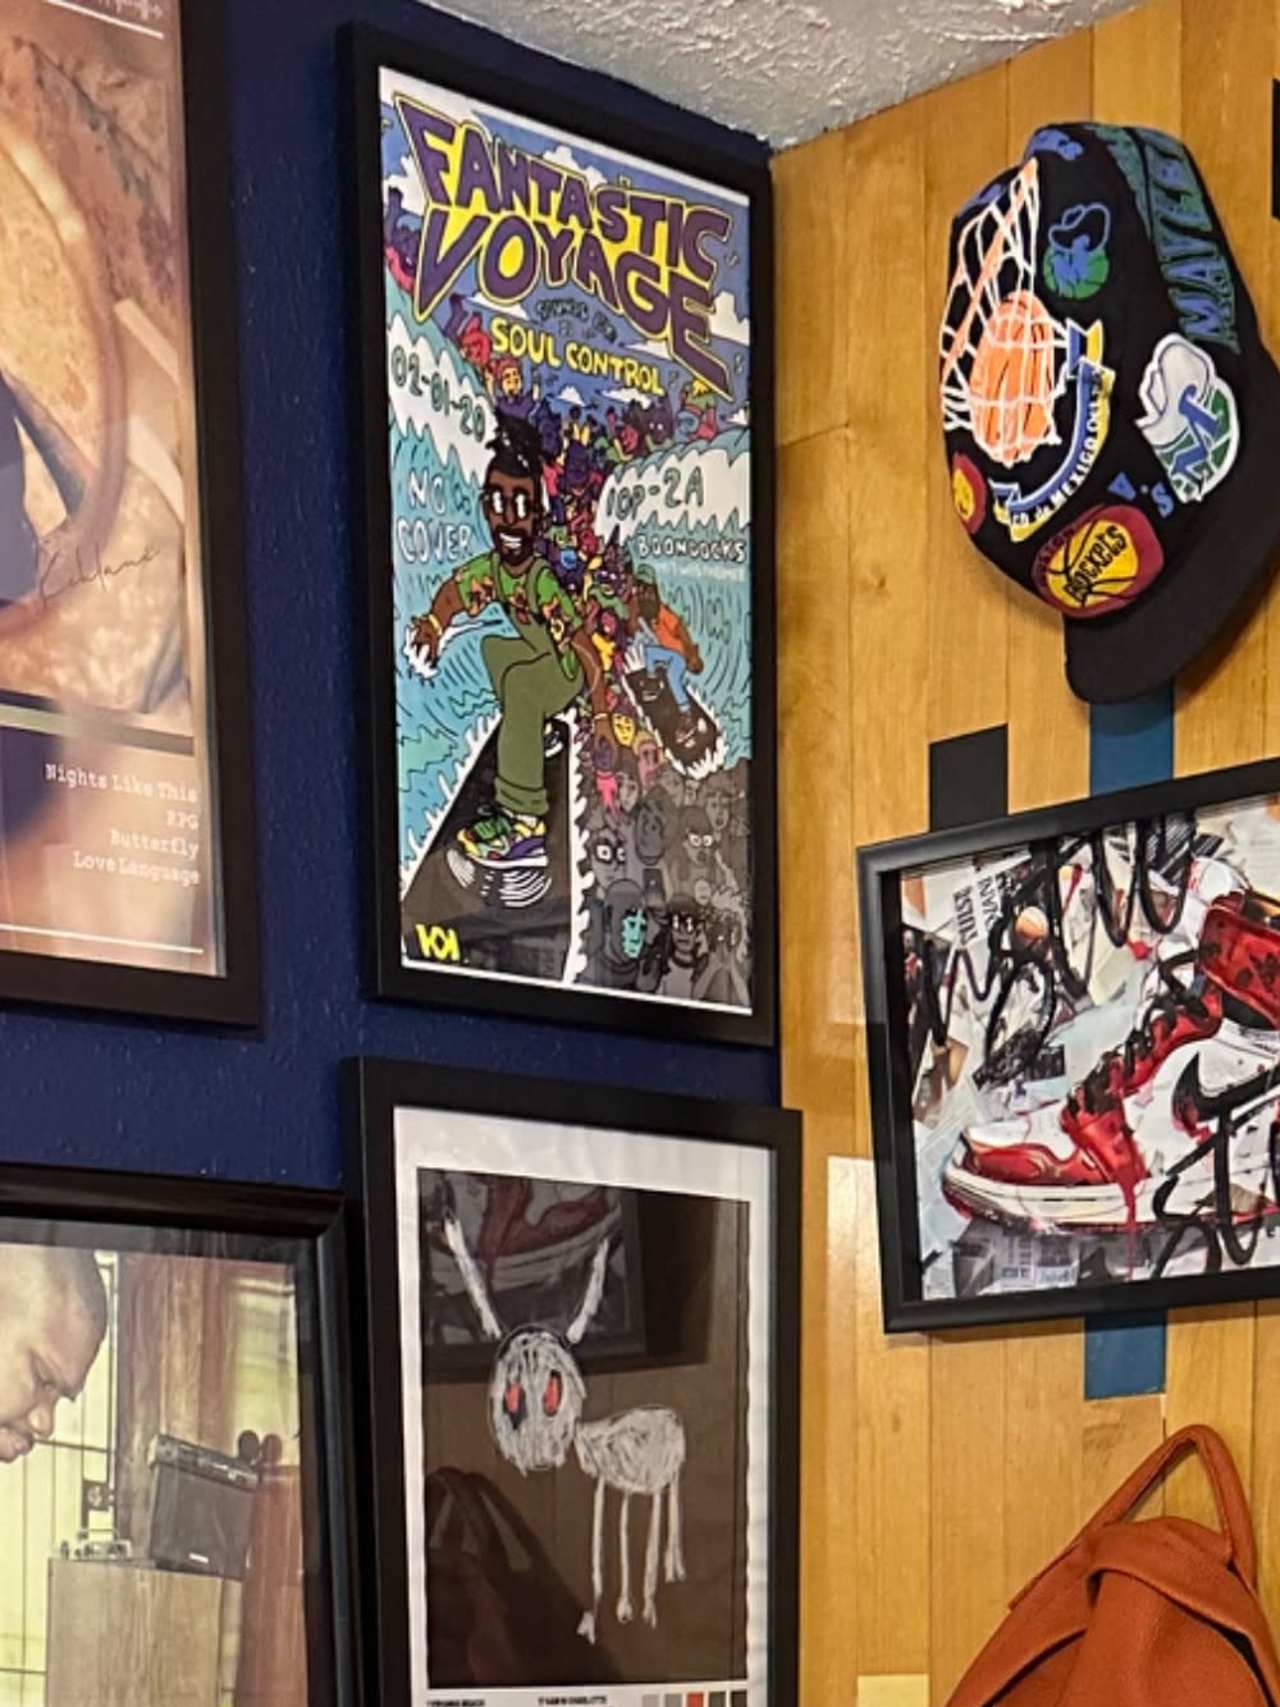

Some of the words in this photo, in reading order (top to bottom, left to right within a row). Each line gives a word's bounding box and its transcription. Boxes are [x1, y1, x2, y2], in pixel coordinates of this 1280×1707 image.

[395, 94, 730, 286] FANTASTIC
[415, 206, 732, 400] VOYAGE
[392, 345, 486, 443] 02-01-20
[491, 319, 561, 368] SOUL
[566, 344, 665, 395] CONTROL
[408, 471, 446, 514] NO
[397, 517, 471, 563] COVER
[1063, 524, 1127, 602] ROCKETS
